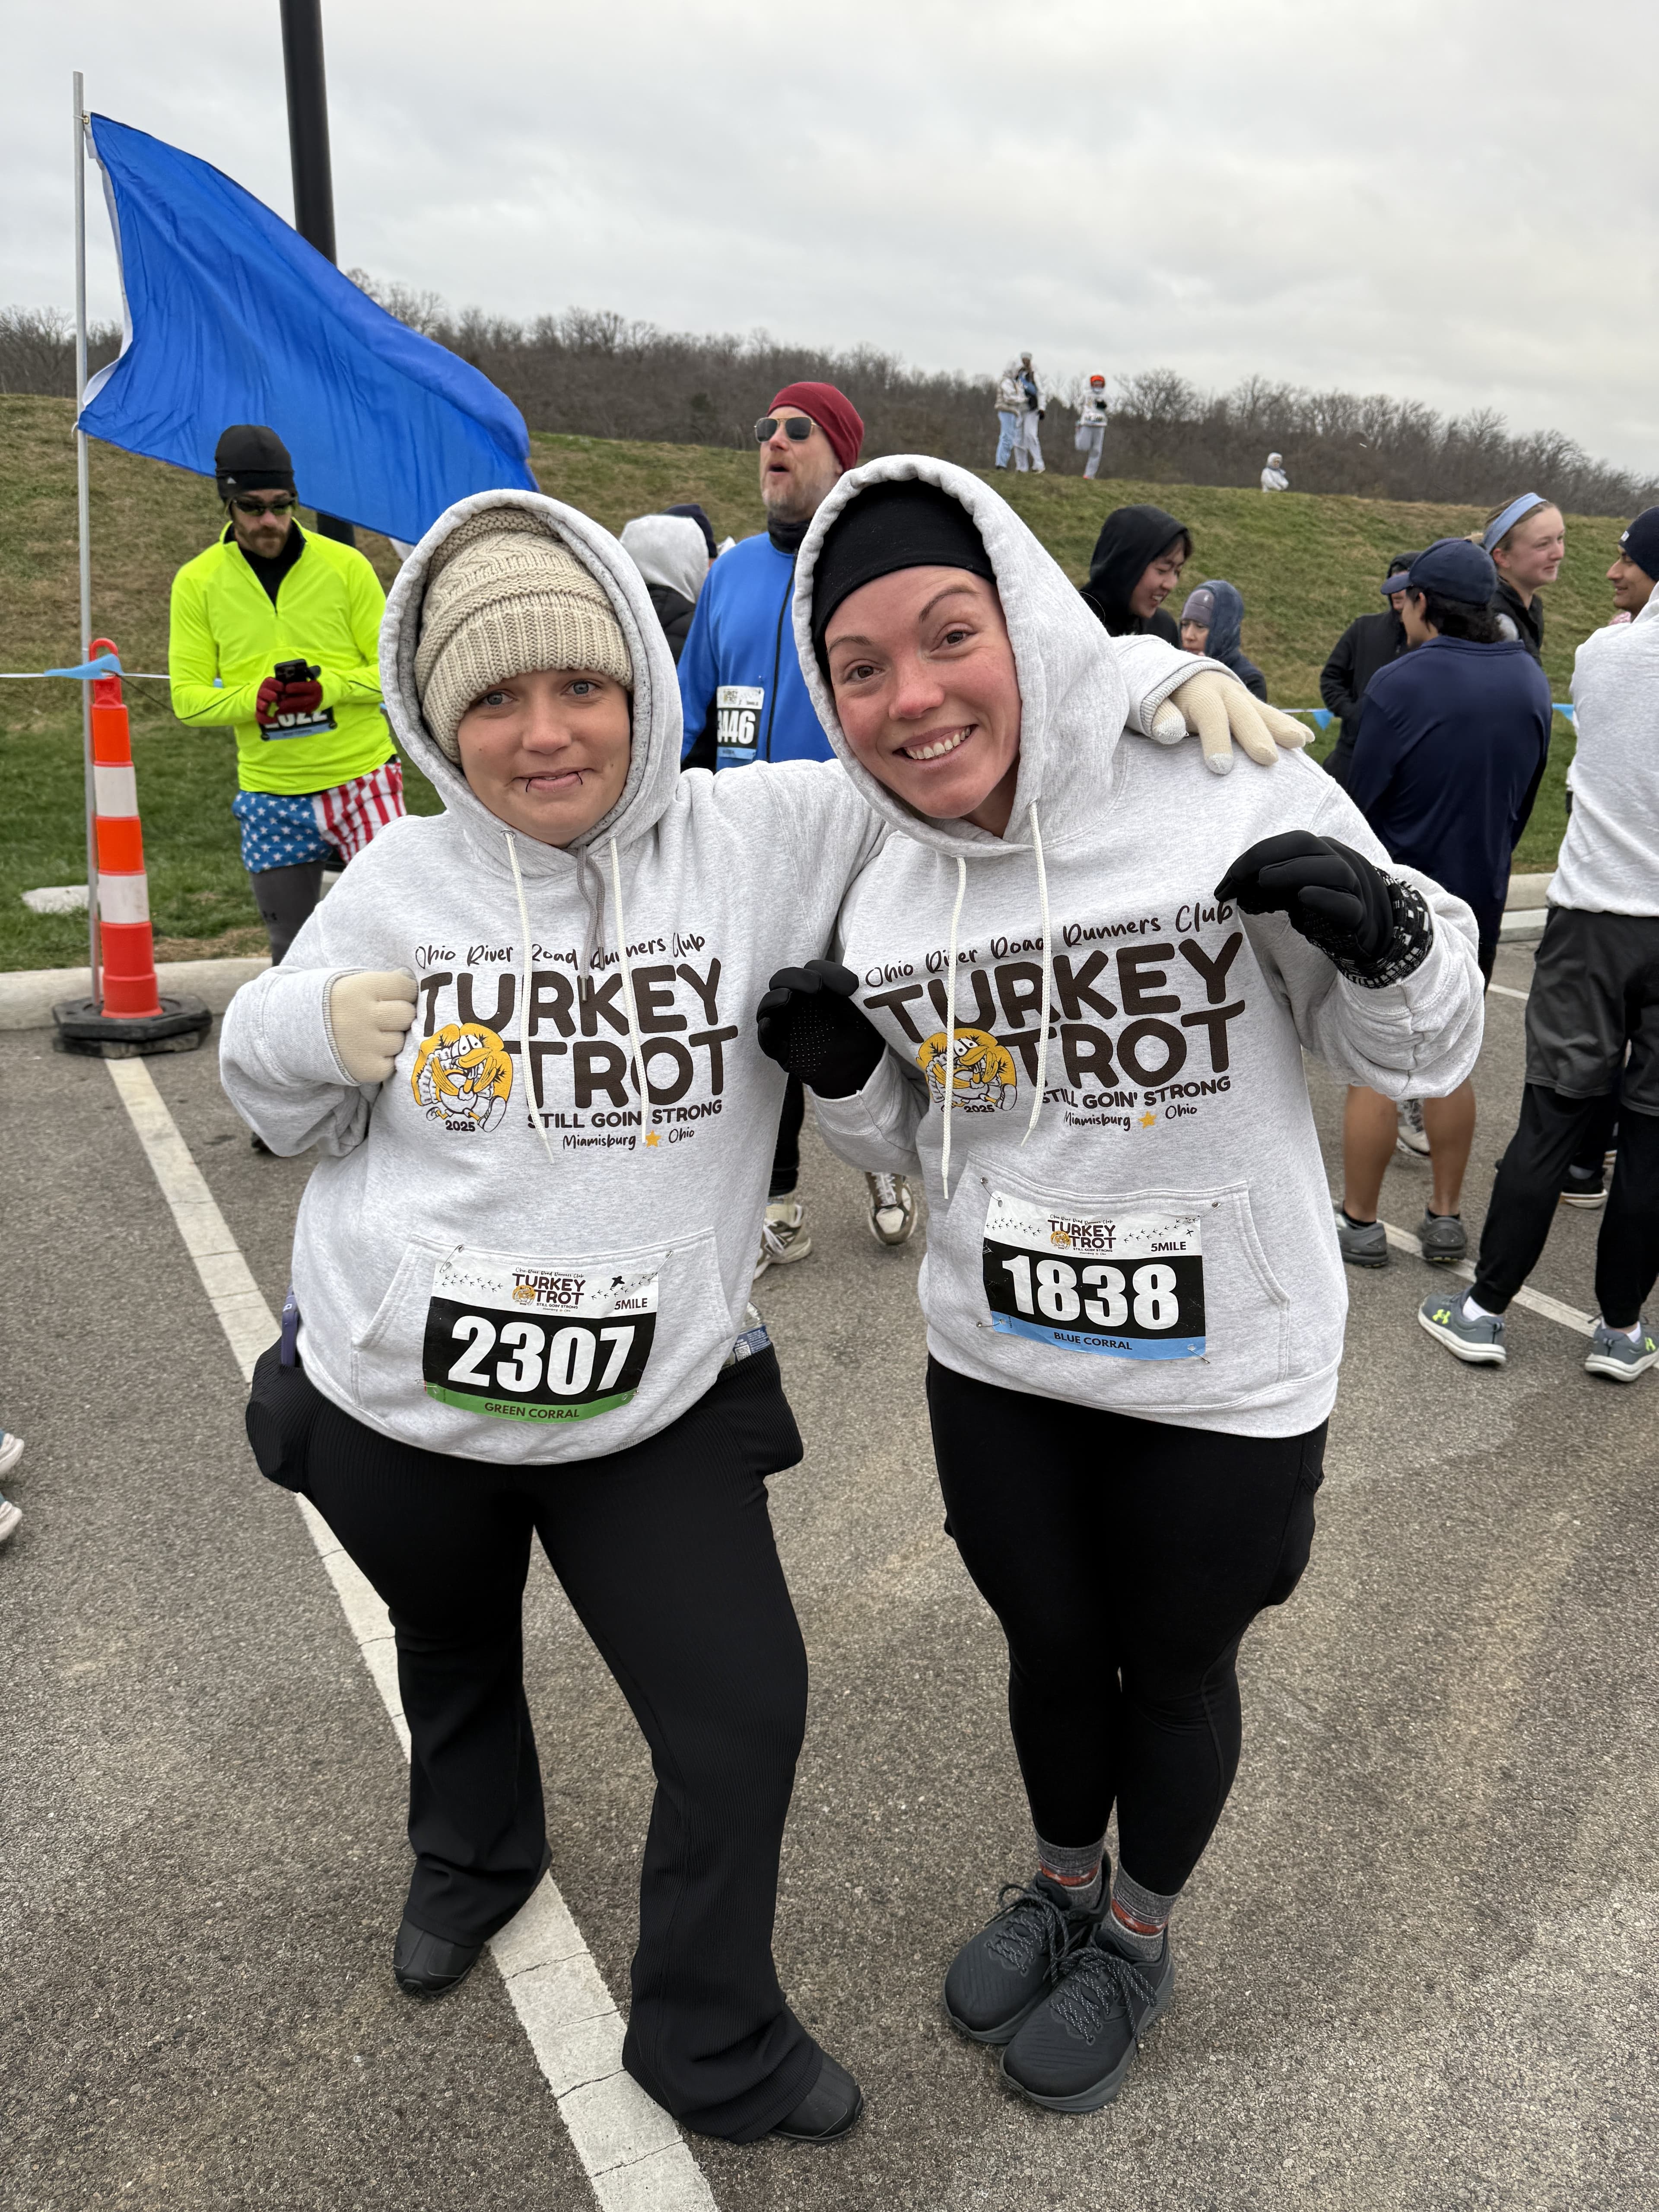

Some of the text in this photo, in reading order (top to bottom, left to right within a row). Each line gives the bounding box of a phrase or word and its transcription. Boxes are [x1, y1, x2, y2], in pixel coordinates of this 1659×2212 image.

[264, 711, 327, 728] 022
[865, 960, 913, 988] Ohio
[925, 949, 978, 974] Rier
[1063, 917, 1161, 948] Runners
[1175, 902, 1233, 933] Club
[415, 945, 456, 969] Ohio
[467, 945, 513, 966] River
[420, 958, 721, 1038] TURKEY
[863, 932, 1243, 1044] TURKEY
[997, 1000, 1245, 1089] TROT
[508, 1025, 738, 1109] TROT
[1082, 1091, 1138, 1109] GOIN'
[1144, 1075, 1231, 1106] STRONG
[652, 1100, 722, 1124] STRONG
[964, 1104, 995, 1112] 2025
[1064, 1104, 1197, 1131] Miamisburg Ohio
[446, 1121, 476, 1131] 2025
[563, 1128, 695, 1150] Miamisburg Ohio
[1048, 1220, 1116, 1236] TURKEY
[1069, 1236, 1116, 1249] TROT
[1150, 1242, 1186, 1252] 5MILE
[512, 1274, 586, 1291] TURKEY
[1002, 1255, 1179, 1330] 1838
[534, 1290, 584, 1304] TROT
[614, 1298, 648, 1310] 5MILE
[1054, 1332, 1133, 1350] BLUE CORRAL
[448, 1316, 636, 1395] 2307
[484, 1402, 580, 1419] GREEN CORRAL
